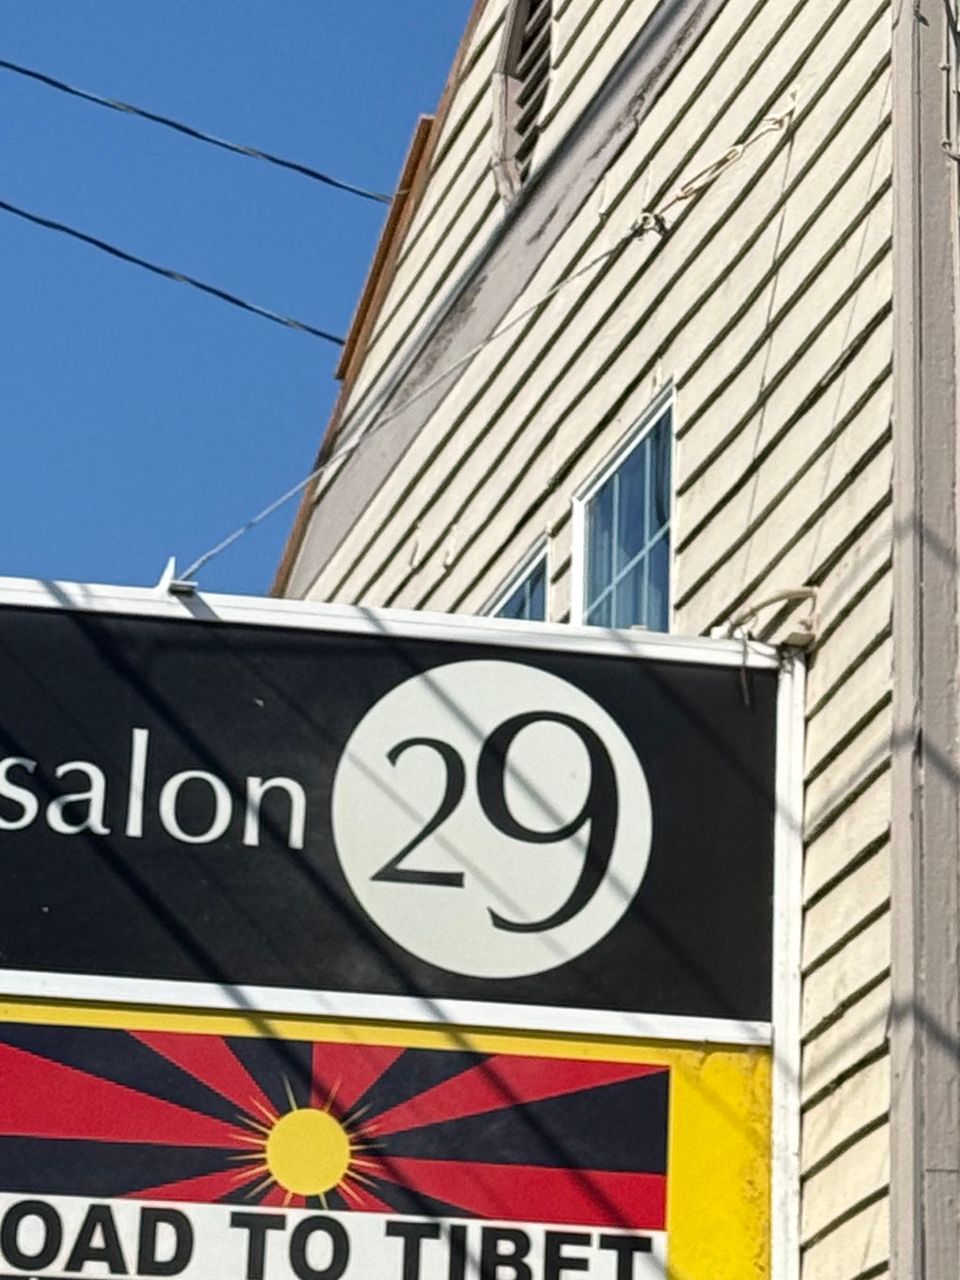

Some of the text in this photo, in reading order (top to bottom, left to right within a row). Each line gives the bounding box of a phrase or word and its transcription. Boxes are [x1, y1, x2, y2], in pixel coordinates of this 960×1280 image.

[0, 710, 620, 933] salon 29
[229, 1210, 352, 1280] TO
[385, 1219, 652, 1280] TIBET
